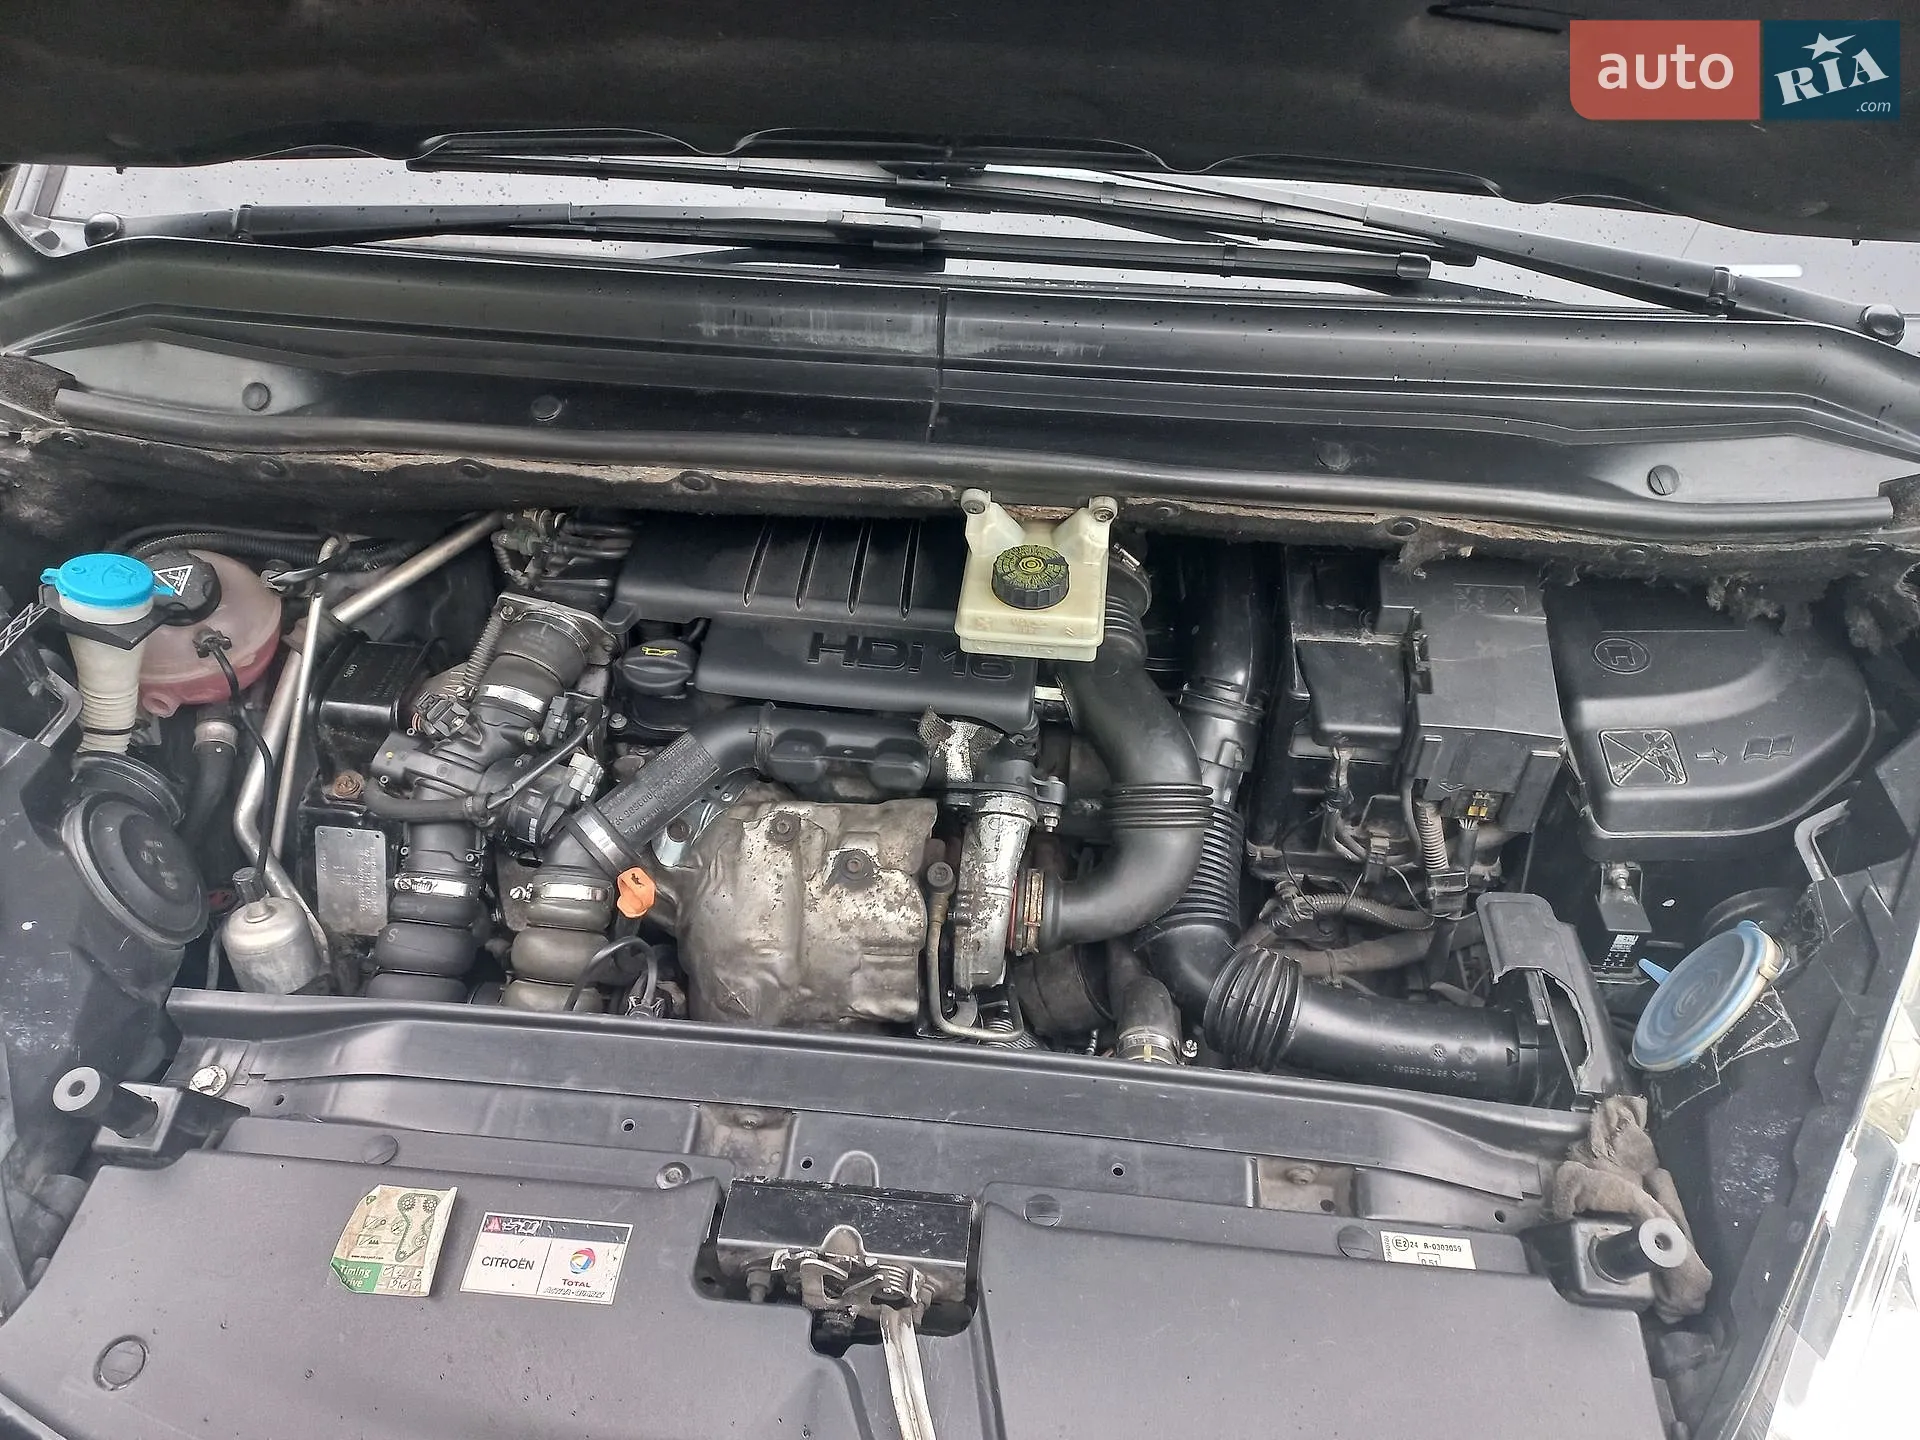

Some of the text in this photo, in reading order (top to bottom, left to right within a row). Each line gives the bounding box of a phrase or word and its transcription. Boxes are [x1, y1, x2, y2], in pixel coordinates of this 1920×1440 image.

[807, 632, 925, 673] HDi
[481, 1255, 535, 1270] CITROËN
[340, 1264, 372, 1279] Timing
